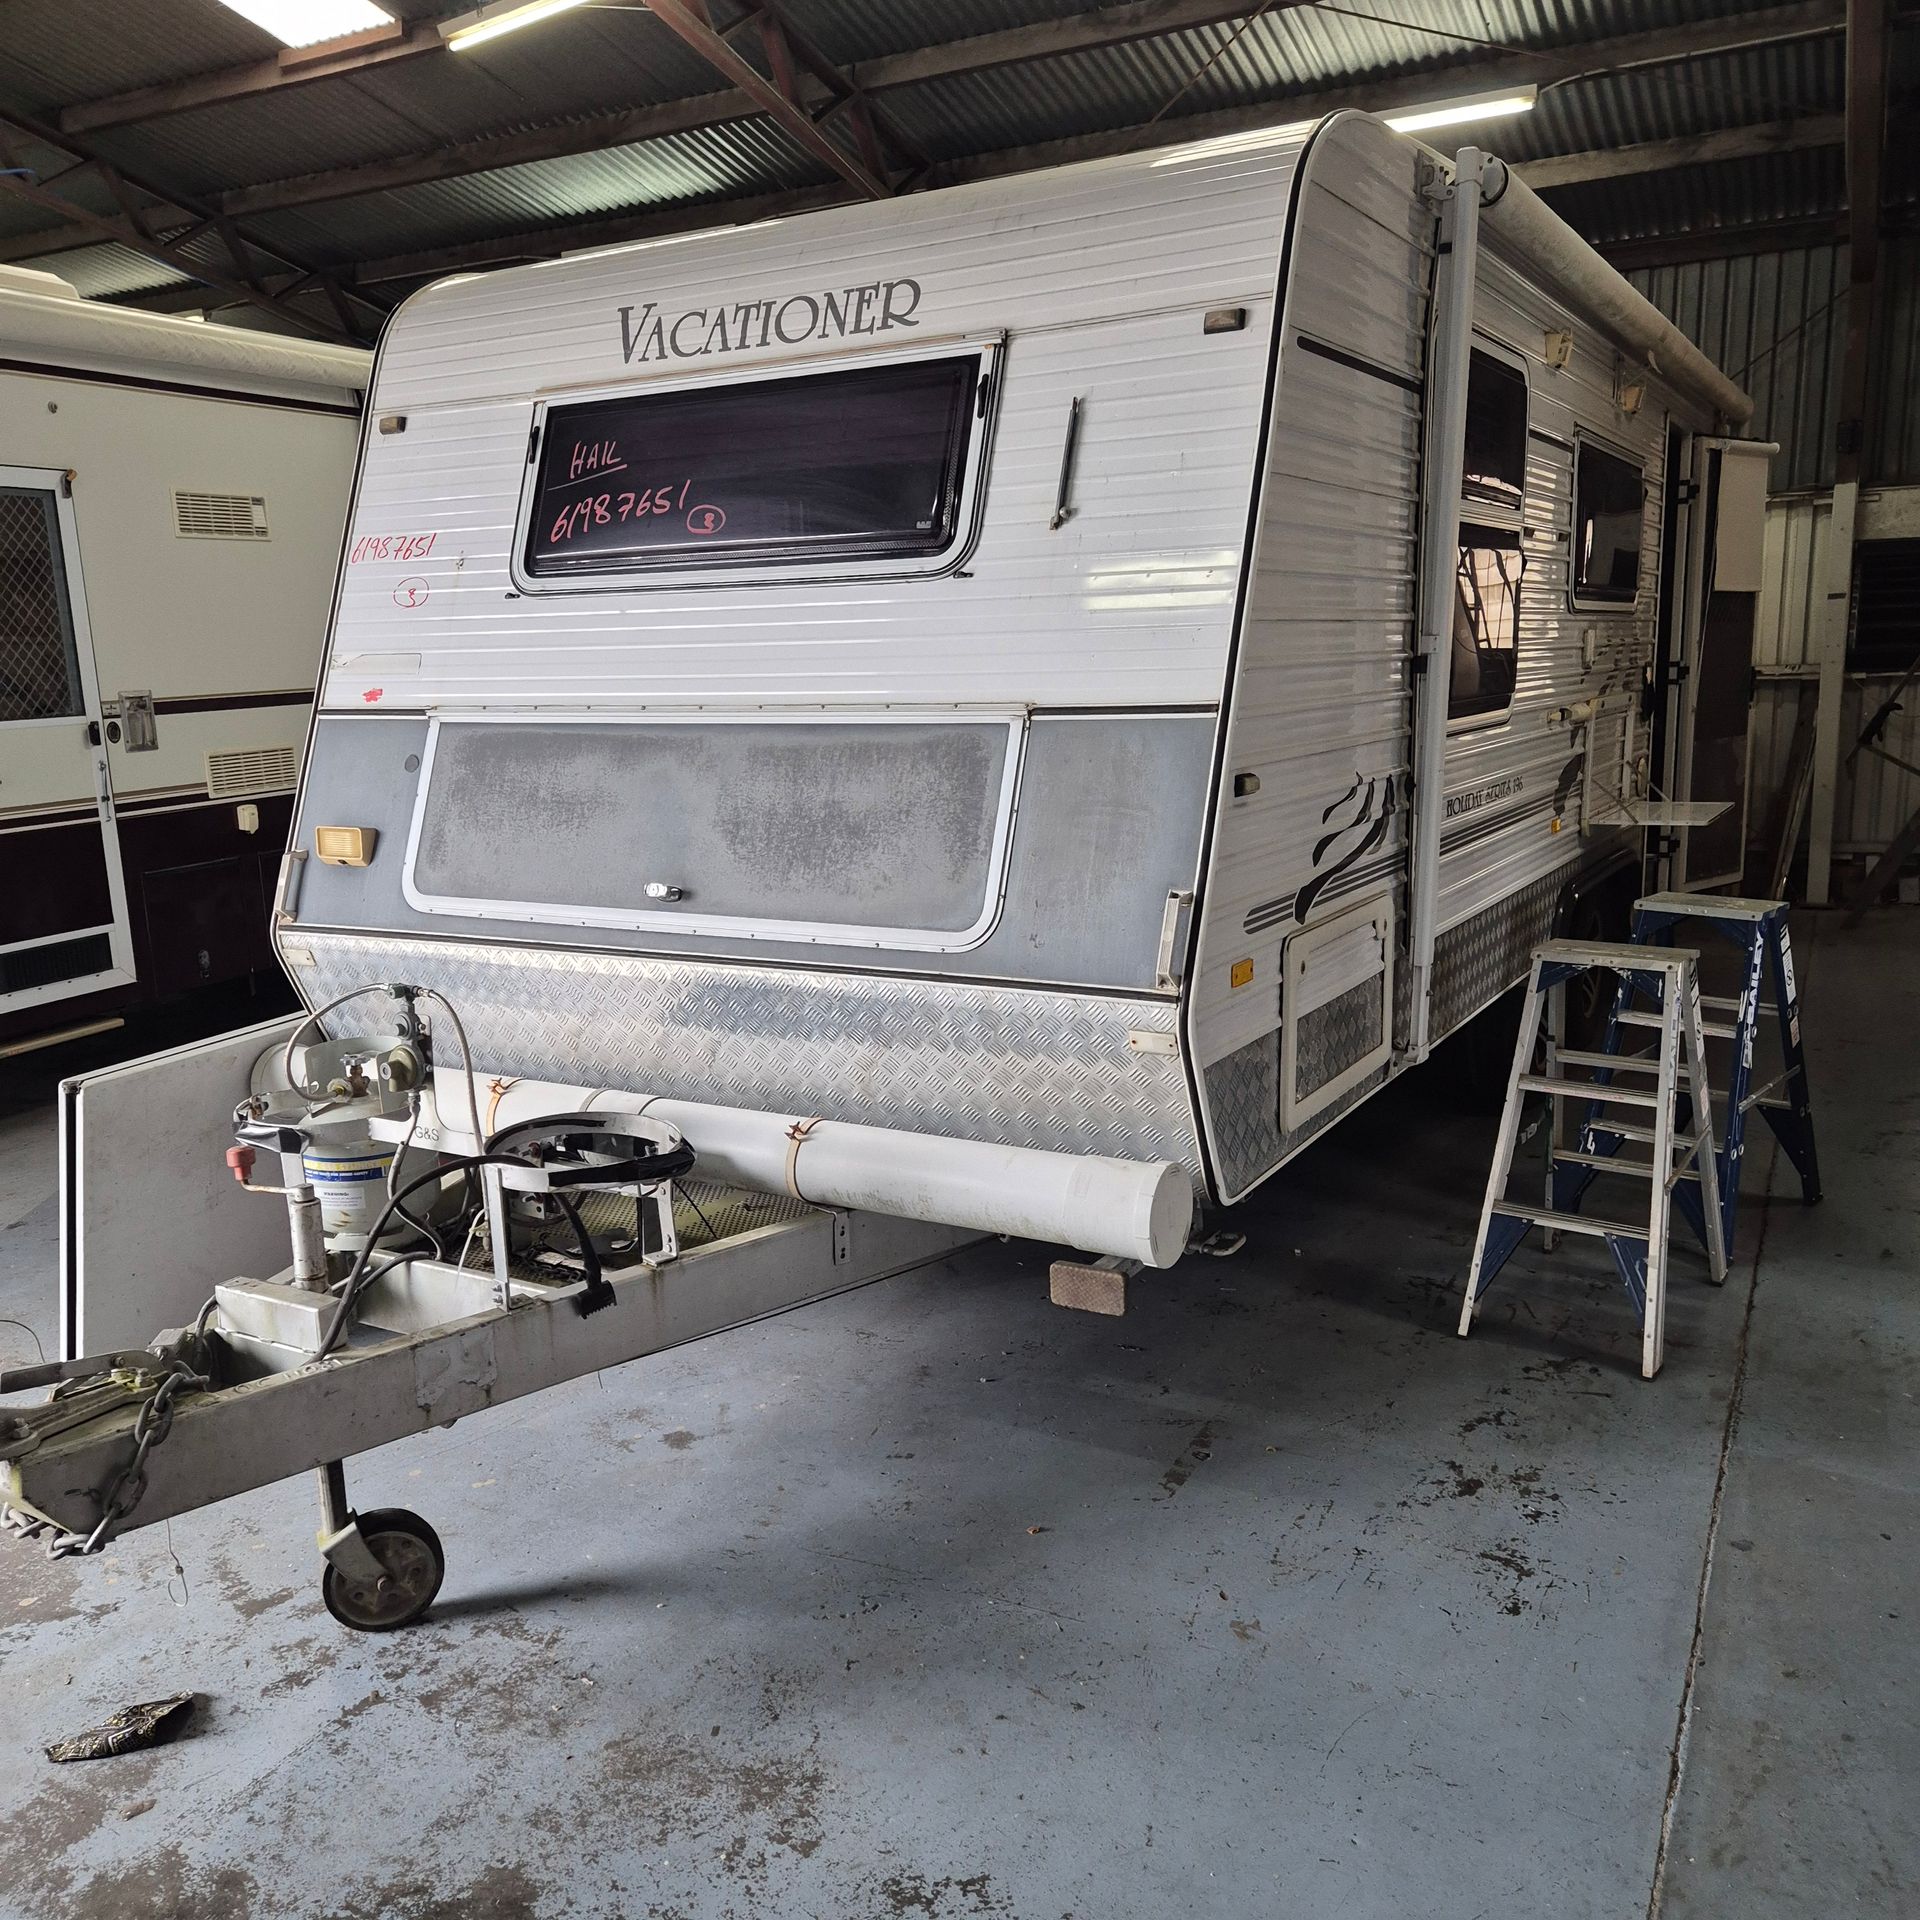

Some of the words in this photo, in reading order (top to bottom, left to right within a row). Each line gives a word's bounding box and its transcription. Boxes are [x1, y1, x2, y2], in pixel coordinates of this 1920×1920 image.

[617, 278, 922, 364] VACATIONER
[570, 440, 622, 479] HAIL
[550, 479, 692, 543] 61987651
[351, 532, 438, 565] 61987651
[414, 1125, 440, 1143] G&S
